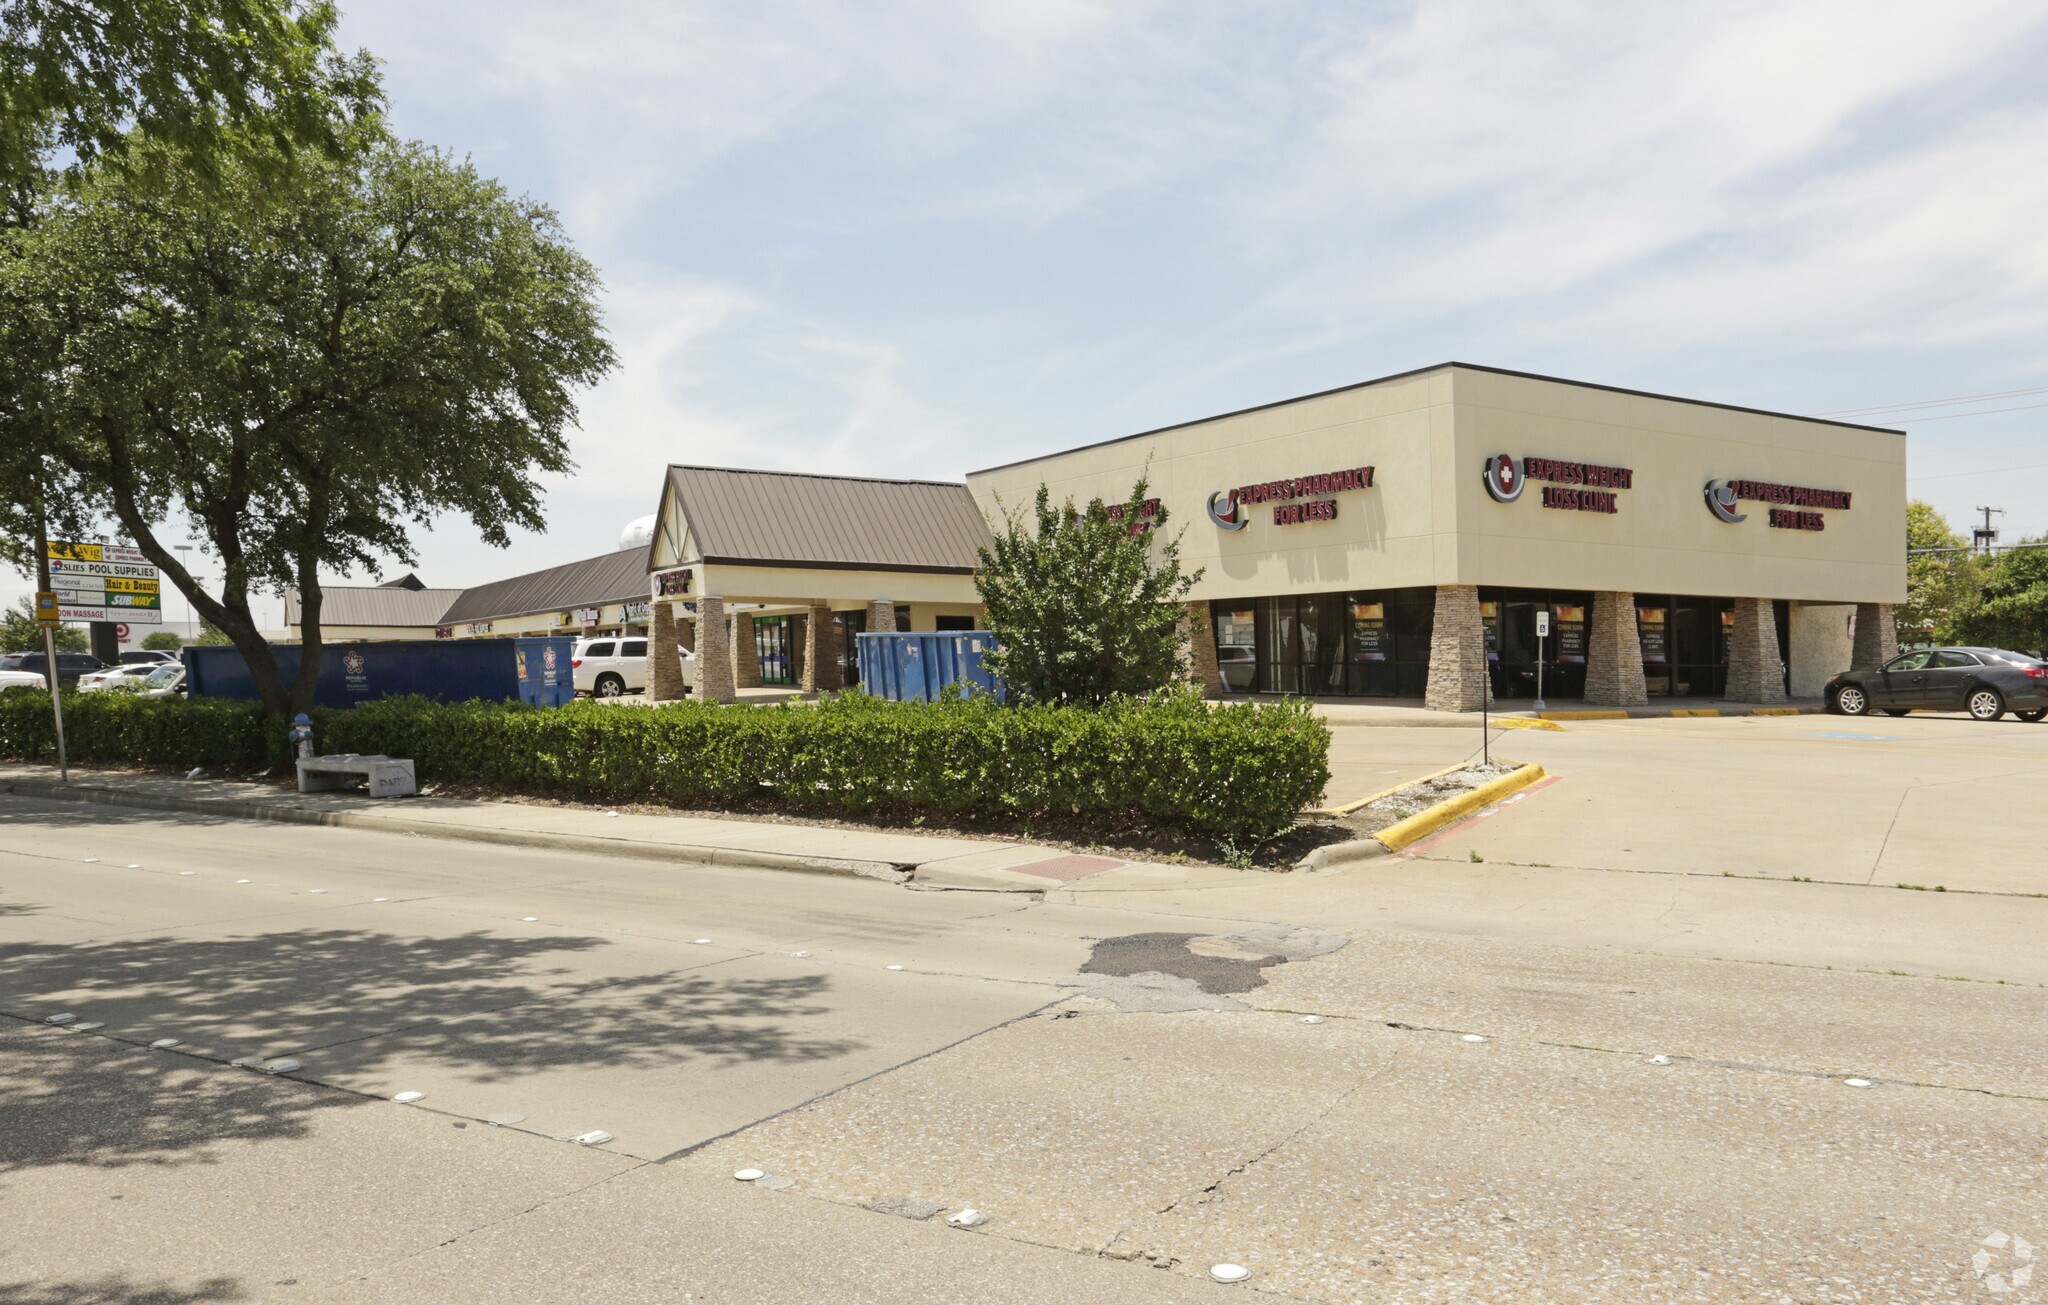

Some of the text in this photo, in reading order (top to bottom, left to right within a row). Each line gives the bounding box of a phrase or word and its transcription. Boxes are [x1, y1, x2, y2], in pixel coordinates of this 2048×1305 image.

[1525, 457, 1633, 489] EXPRESS WEIGHT
[1239, 466, 1374, 505] EXPRESS PHARMACY
[1739, 480, 1852, 510] EXPRESS PHARMACY
[1273, 499, 1337, 525] FOR LESS
[1545, 487, 1618, 514] LOSS CLINIC
[1772, 509, 1824, 531] FOR LESS
[89, 564, 112, 573] POOL
[115, 566, 154, 576] SUPPLIES
[106, 579, 122, 589] Hair
[133, 581, 158, 593] Beauty
[111, 595, 155, 606] SUBWAY
[73, 610, 104, 619] MASSAGE
